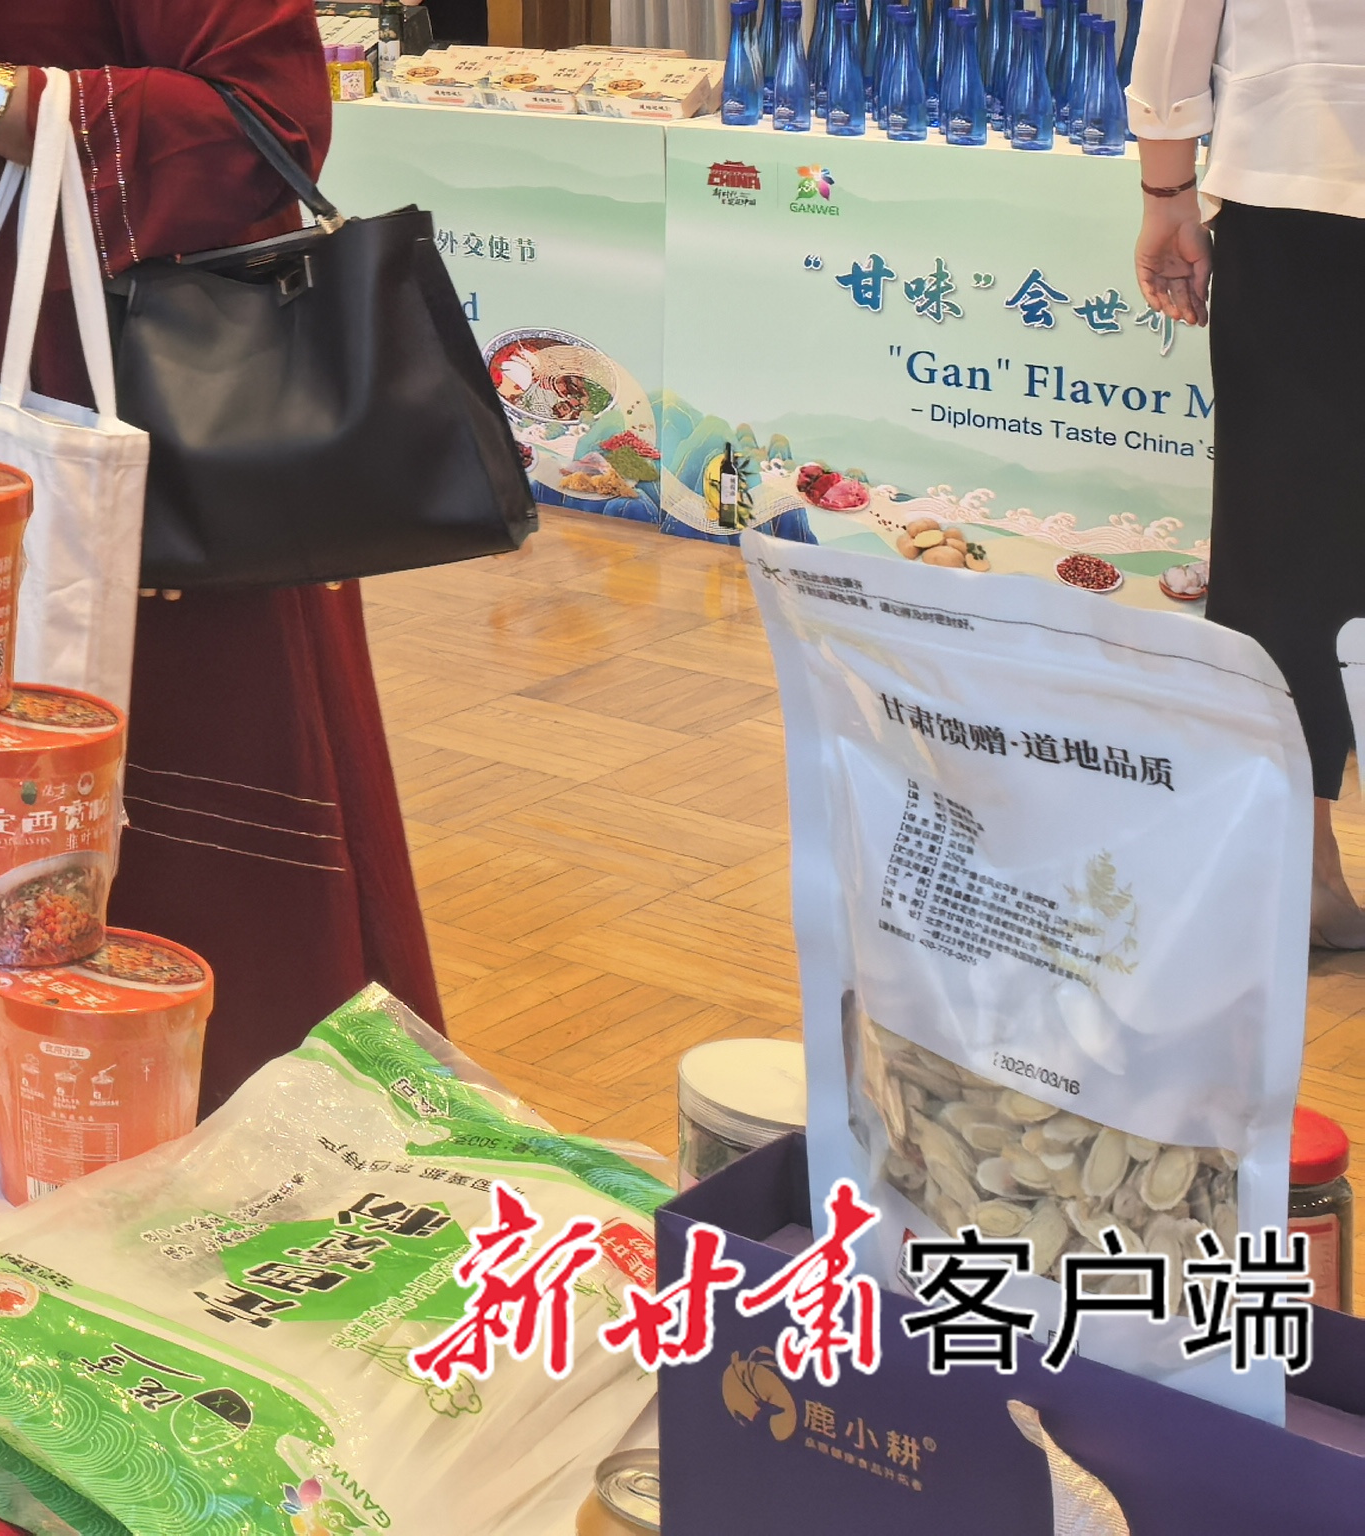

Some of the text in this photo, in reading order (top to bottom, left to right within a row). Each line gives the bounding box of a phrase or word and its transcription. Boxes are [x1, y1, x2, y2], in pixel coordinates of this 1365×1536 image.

[789, 202, 840, 216] GANWEI
[436, 229, 536, 263] 外交使节
[888, 345, 1010, 392] "Gan"
[1024, 363, 1171, 414] Flavor
[930, 404, 1043, 437] Diplomats
[1050, 420, 1117, 447] Taste
[878, 692, 1176, 793] 甘肃馈赠·道地品质
[804, 1399, 921, 1472] 鹿小耕
